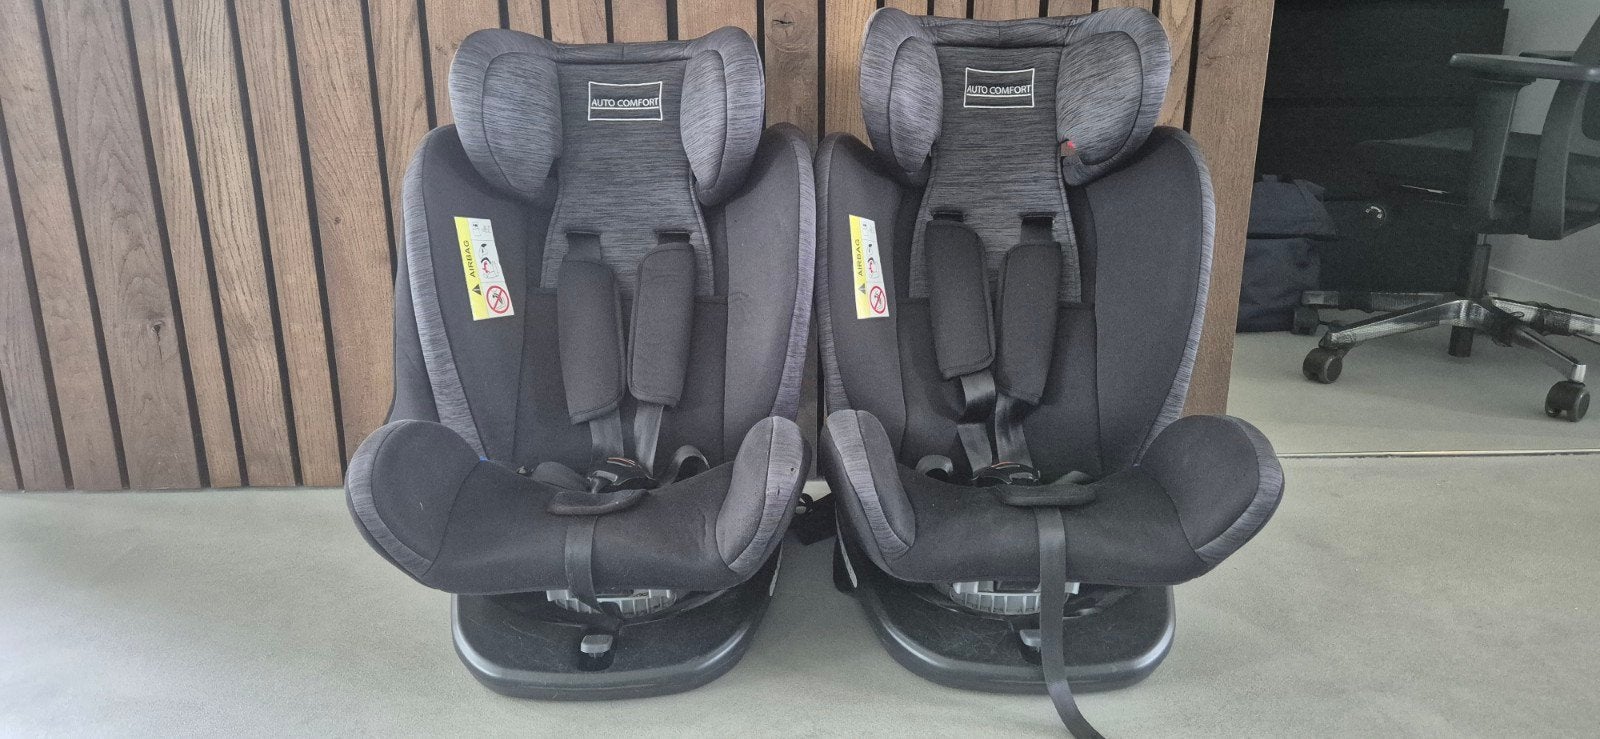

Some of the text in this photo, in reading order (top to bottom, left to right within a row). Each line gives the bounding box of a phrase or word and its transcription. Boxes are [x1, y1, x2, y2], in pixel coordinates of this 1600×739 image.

[966, 84, 1032, 95] AUTO COMFORT
[591, 97, 659, 107] AUTO COMFORT
[463, 240, 476, 278] AIRBAG
[854, 238, 864, 277] AIRBAG
